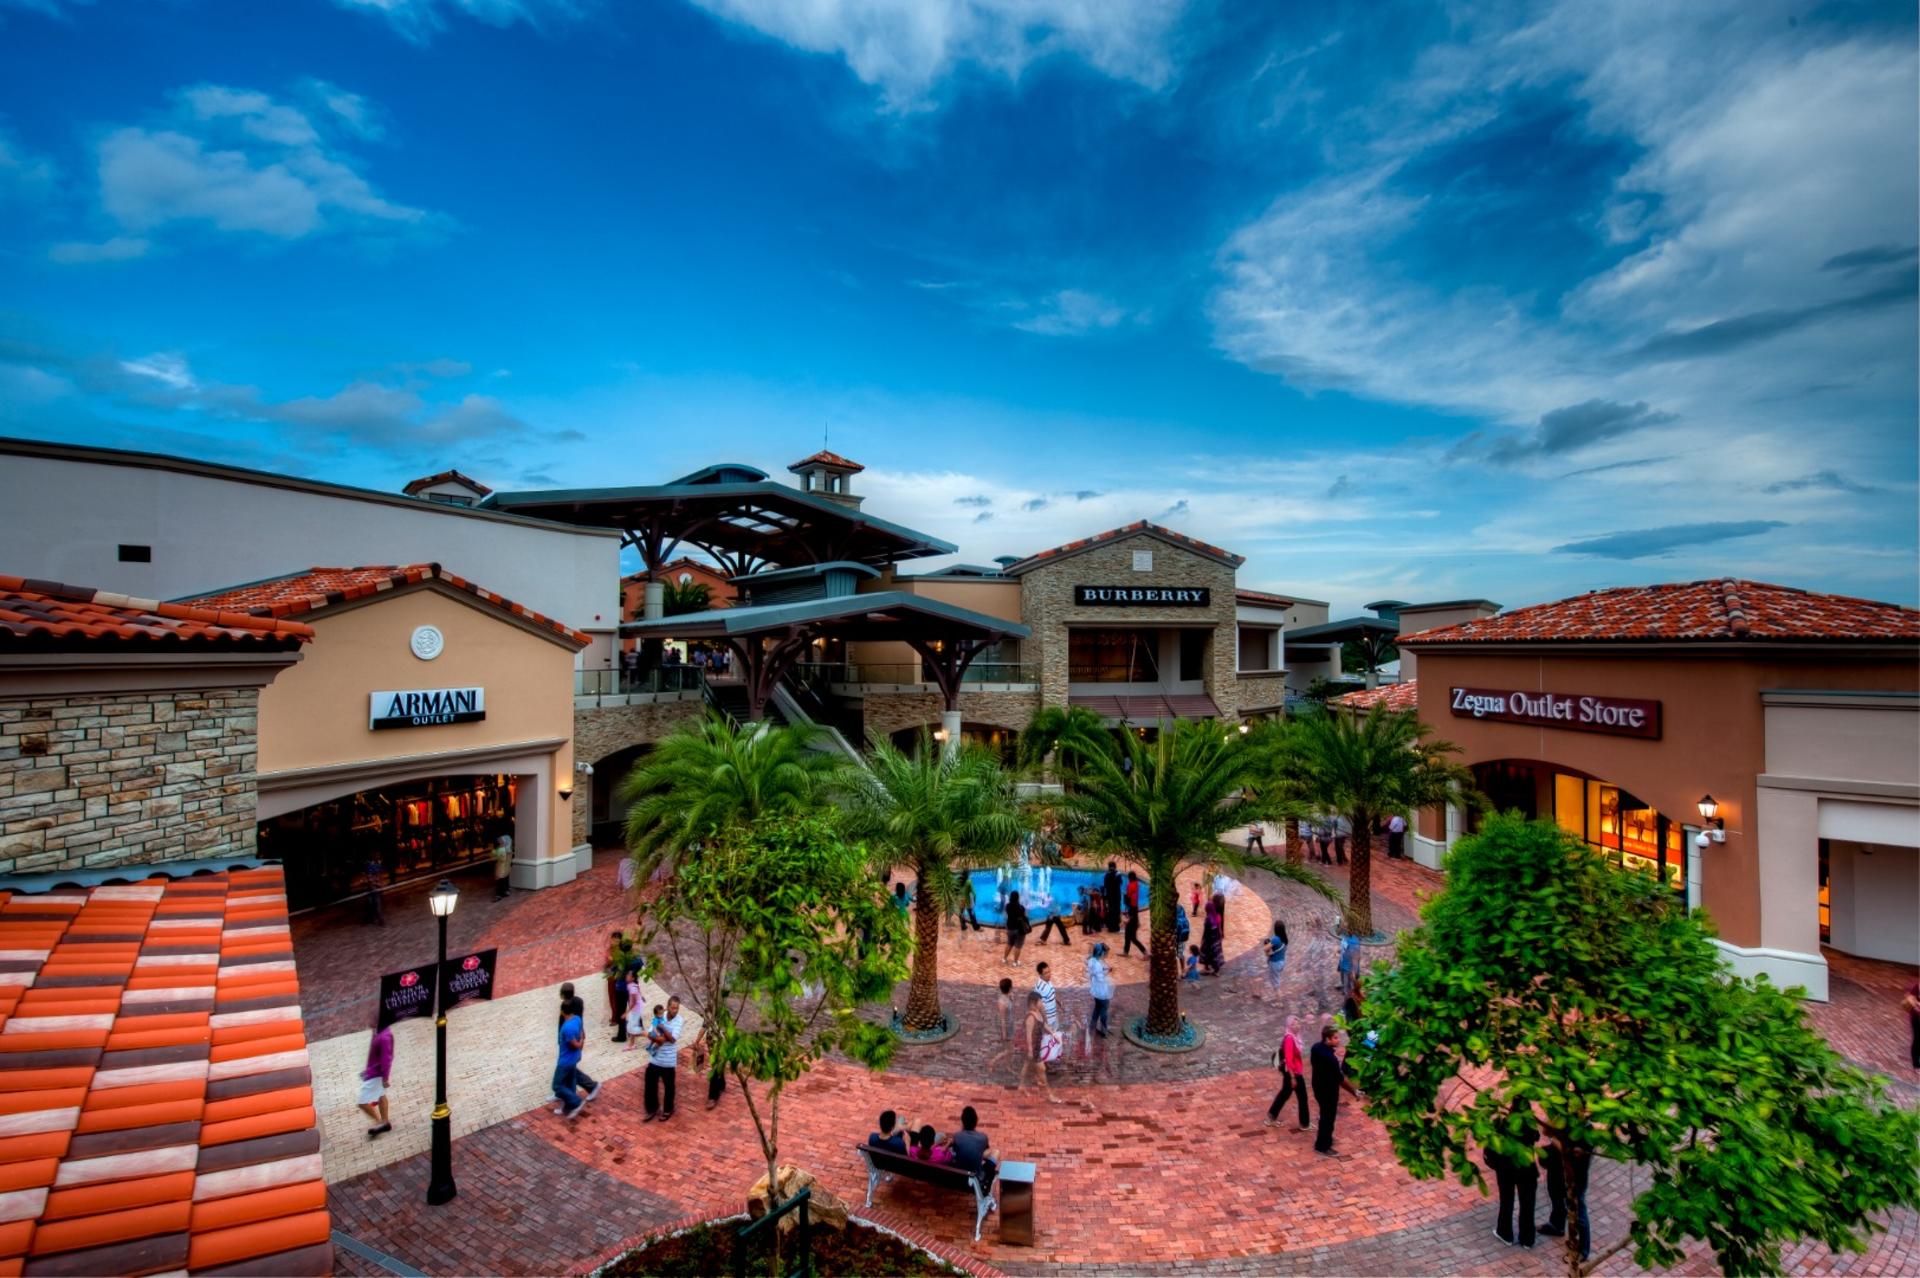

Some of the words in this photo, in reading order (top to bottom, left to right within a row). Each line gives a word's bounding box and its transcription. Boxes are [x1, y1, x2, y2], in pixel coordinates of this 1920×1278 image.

[1083, 589, 1203, 601] BURBERRY
[387, 690, 476, 717] ARMANI
[1453, 688, 1504, 717] Zegna
[1510, 692, 1573, 720] Outlet
[1580, 697, 1645, 728] Store
[413, 714, 455, 725] OUTLET
